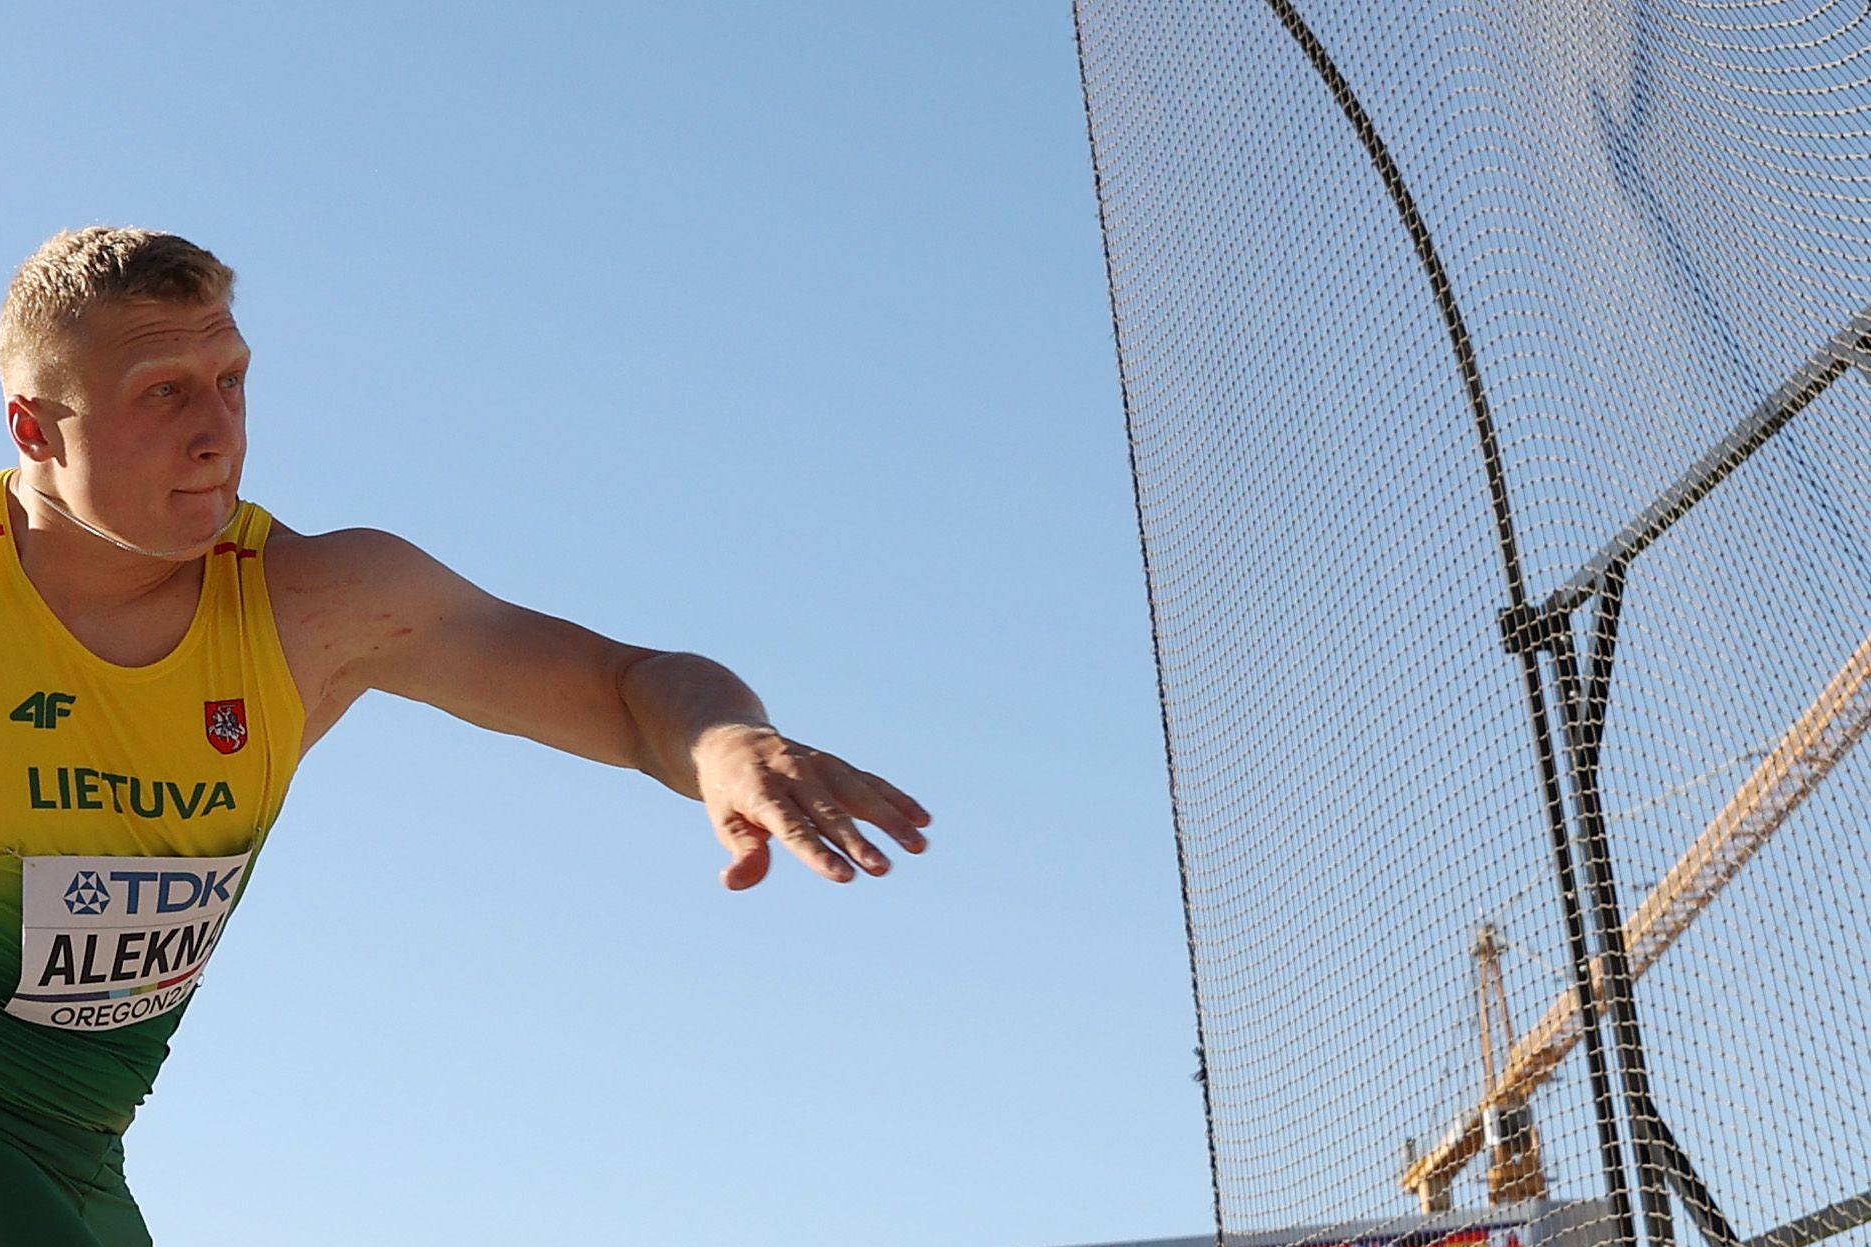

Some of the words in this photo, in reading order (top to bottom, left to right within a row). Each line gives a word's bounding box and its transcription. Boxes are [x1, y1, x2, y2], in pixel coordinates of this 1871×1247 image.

[9, 691, 76, 729] 4F
[28, 767, 236, 820] LIETUVA
[110, 865, 242, 915] TDK
[38, 912, 226, 987] ALEKNA
